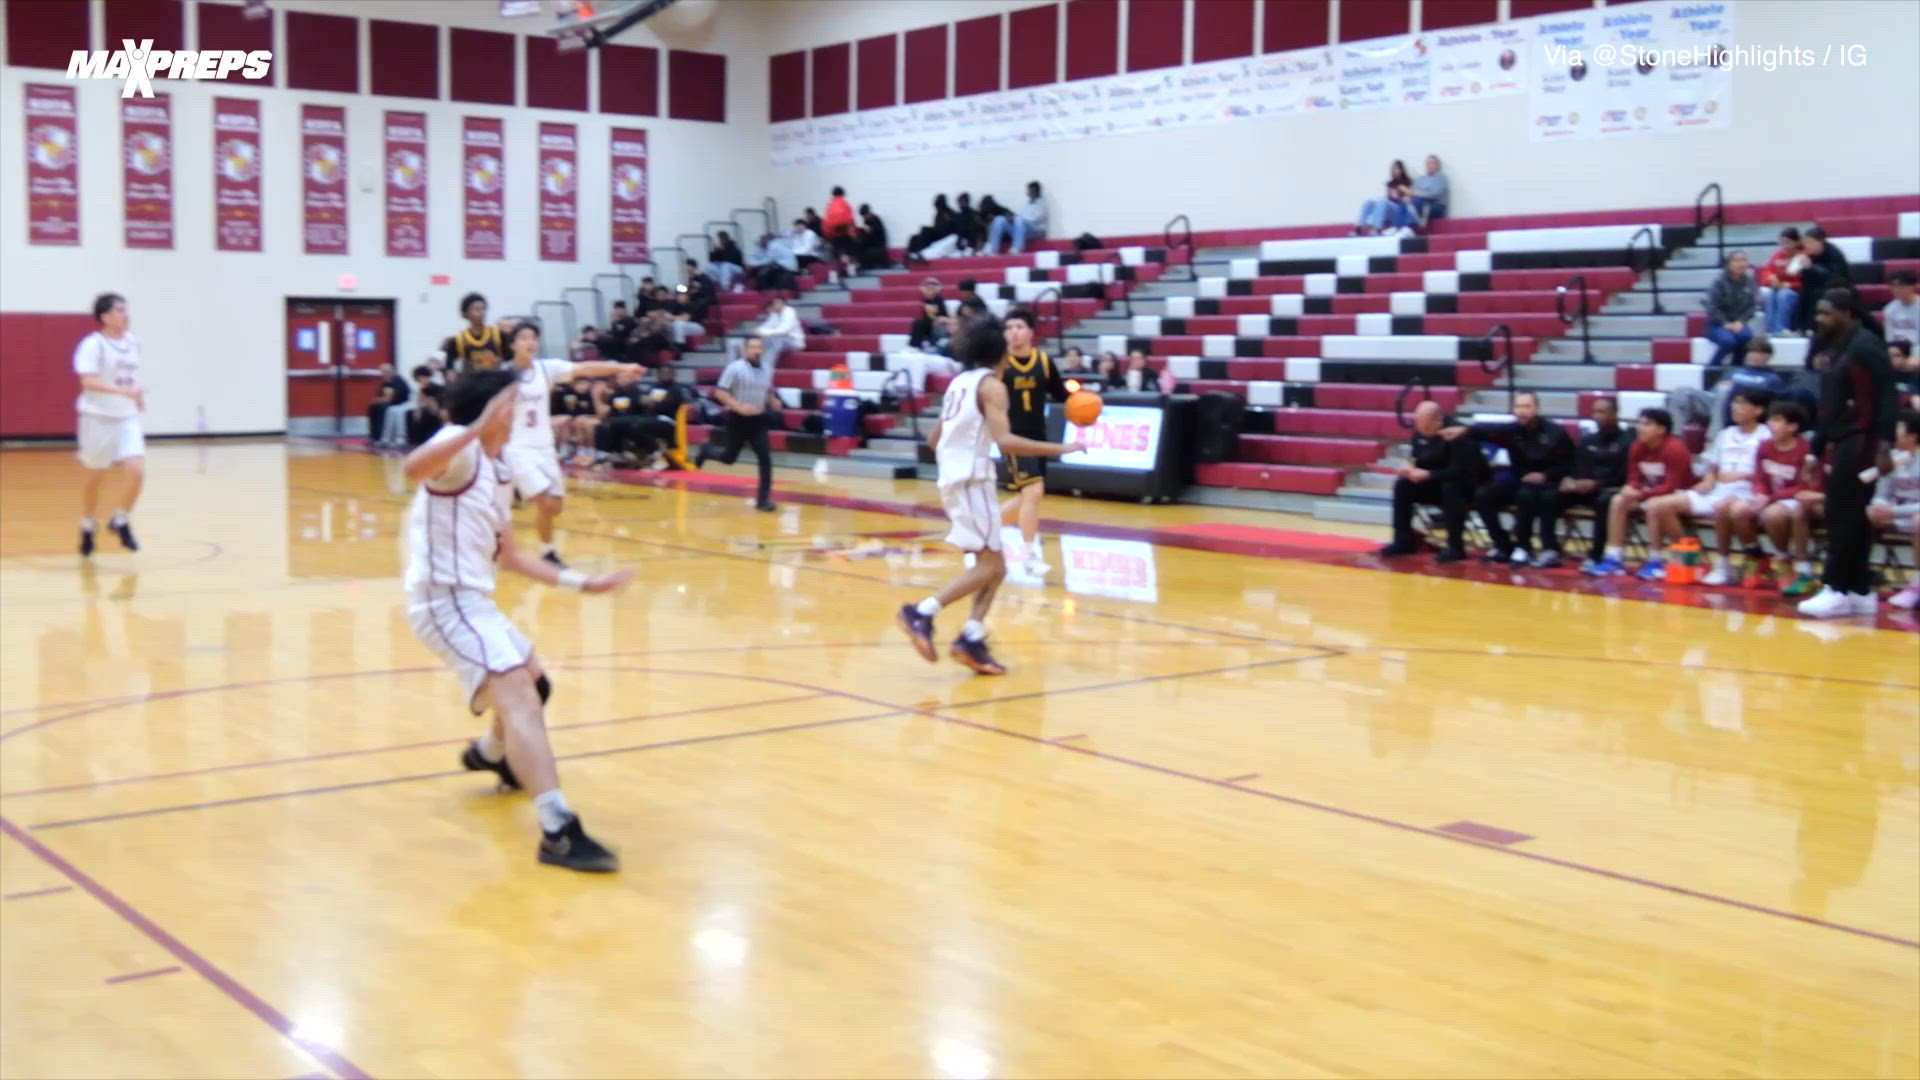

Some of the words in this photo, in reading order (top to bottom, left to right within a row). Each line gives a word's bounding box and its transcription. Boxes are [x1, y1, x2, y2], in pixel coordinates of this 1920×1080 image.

[1689, 20, 1721, 32] Year
[1619, 29, 1650, 40] Year
[1022, 389, 1032, 412] 1
